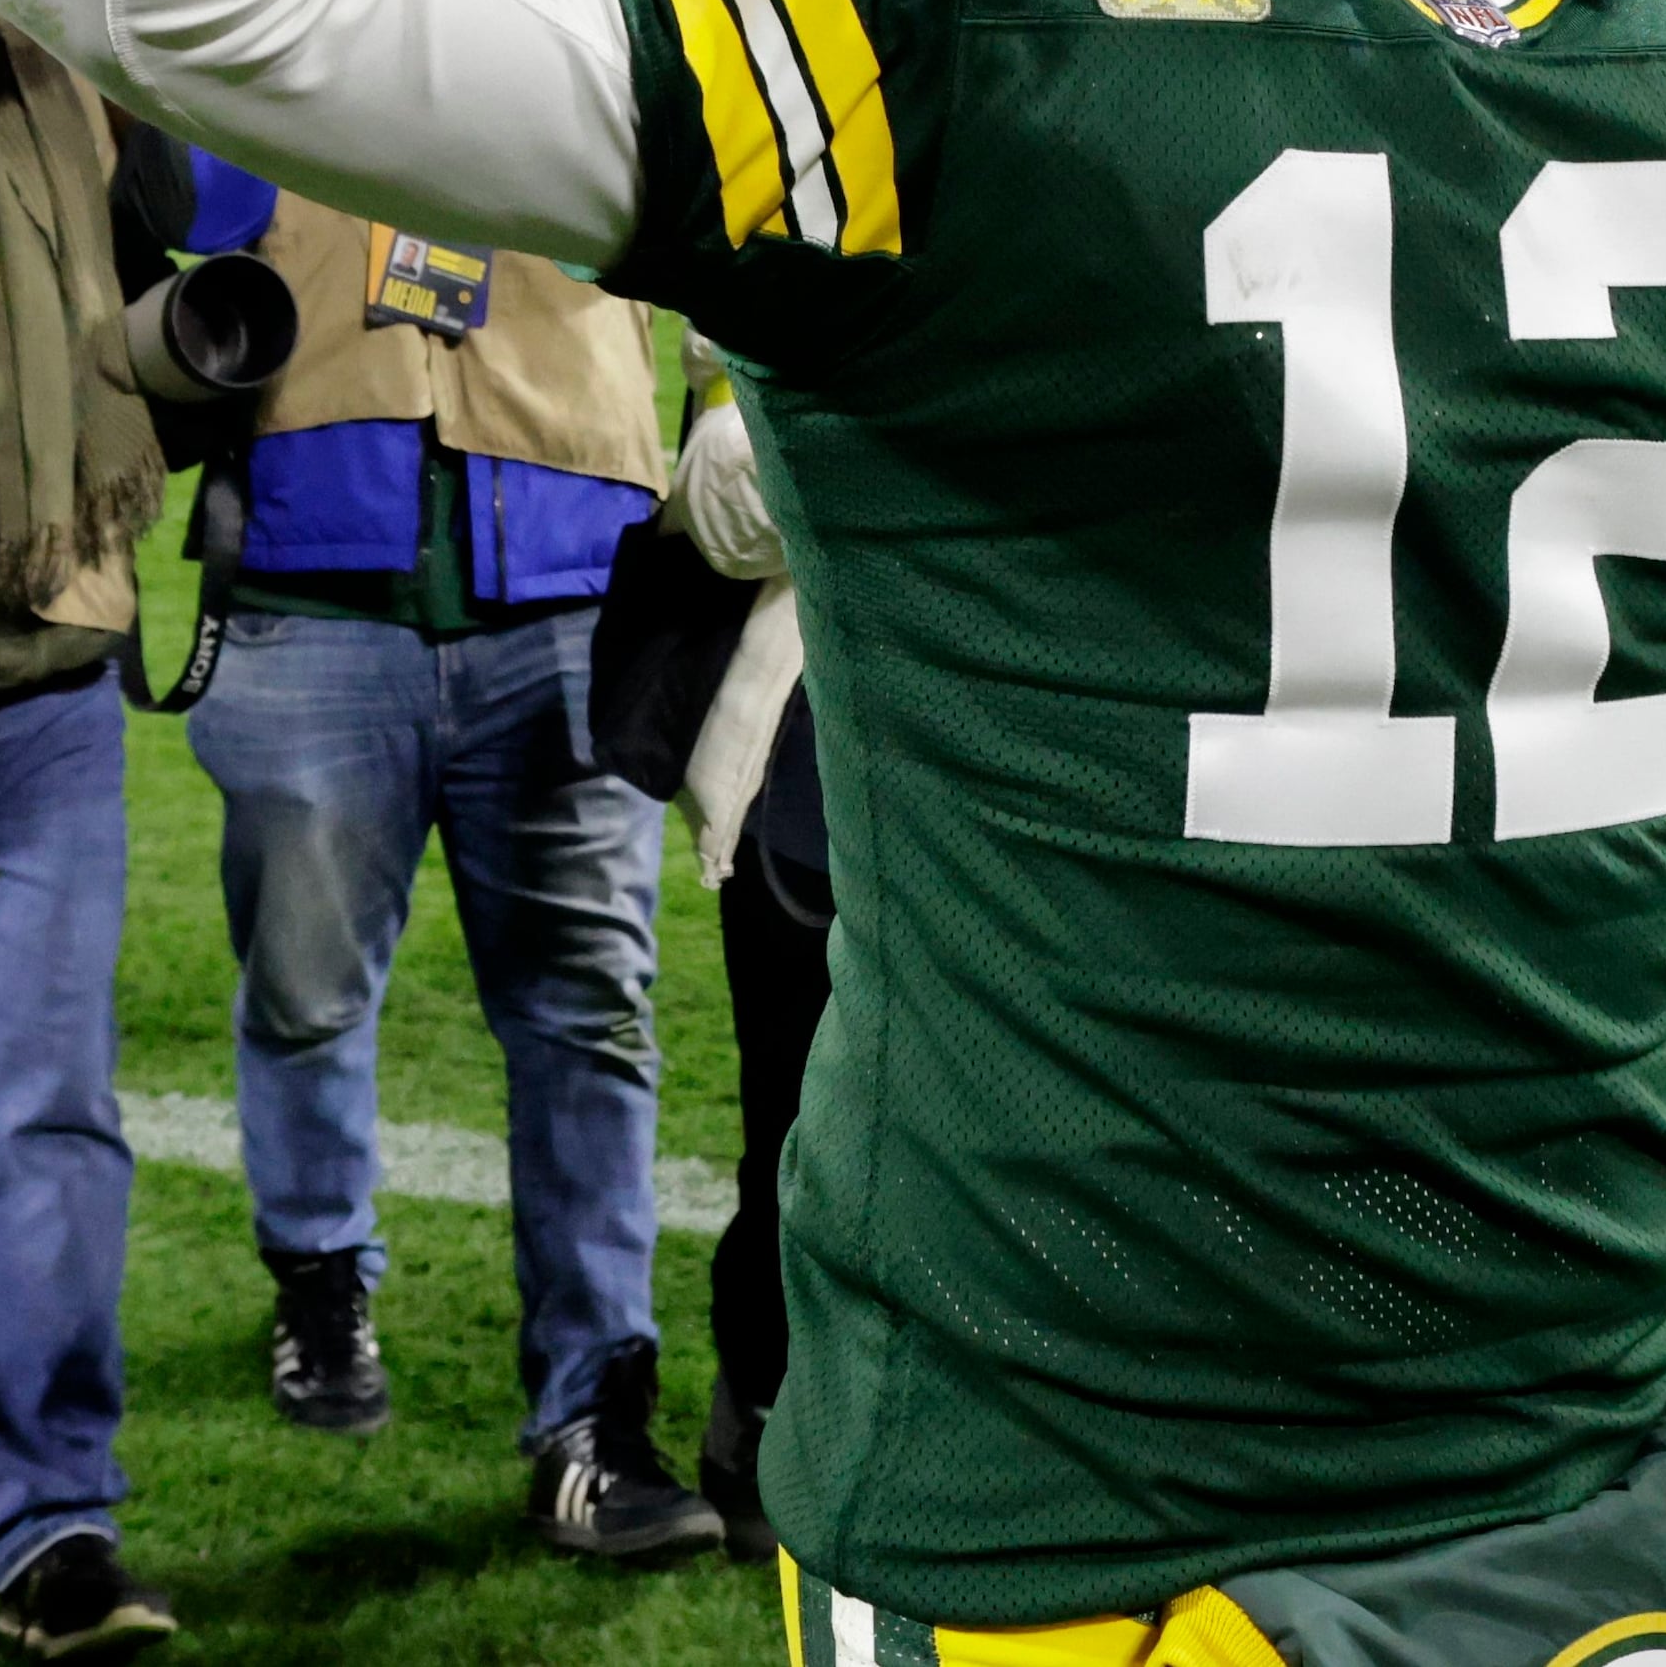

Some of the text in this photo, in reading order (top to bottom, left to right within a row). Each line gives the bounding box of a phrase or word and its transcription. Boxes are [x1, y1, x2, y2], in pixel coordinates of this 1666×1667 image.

[1445, 6, 1506, 30] NFL
[381, 277, 437, 320] MEDIA
[181, 614, 220, 694] SONY
